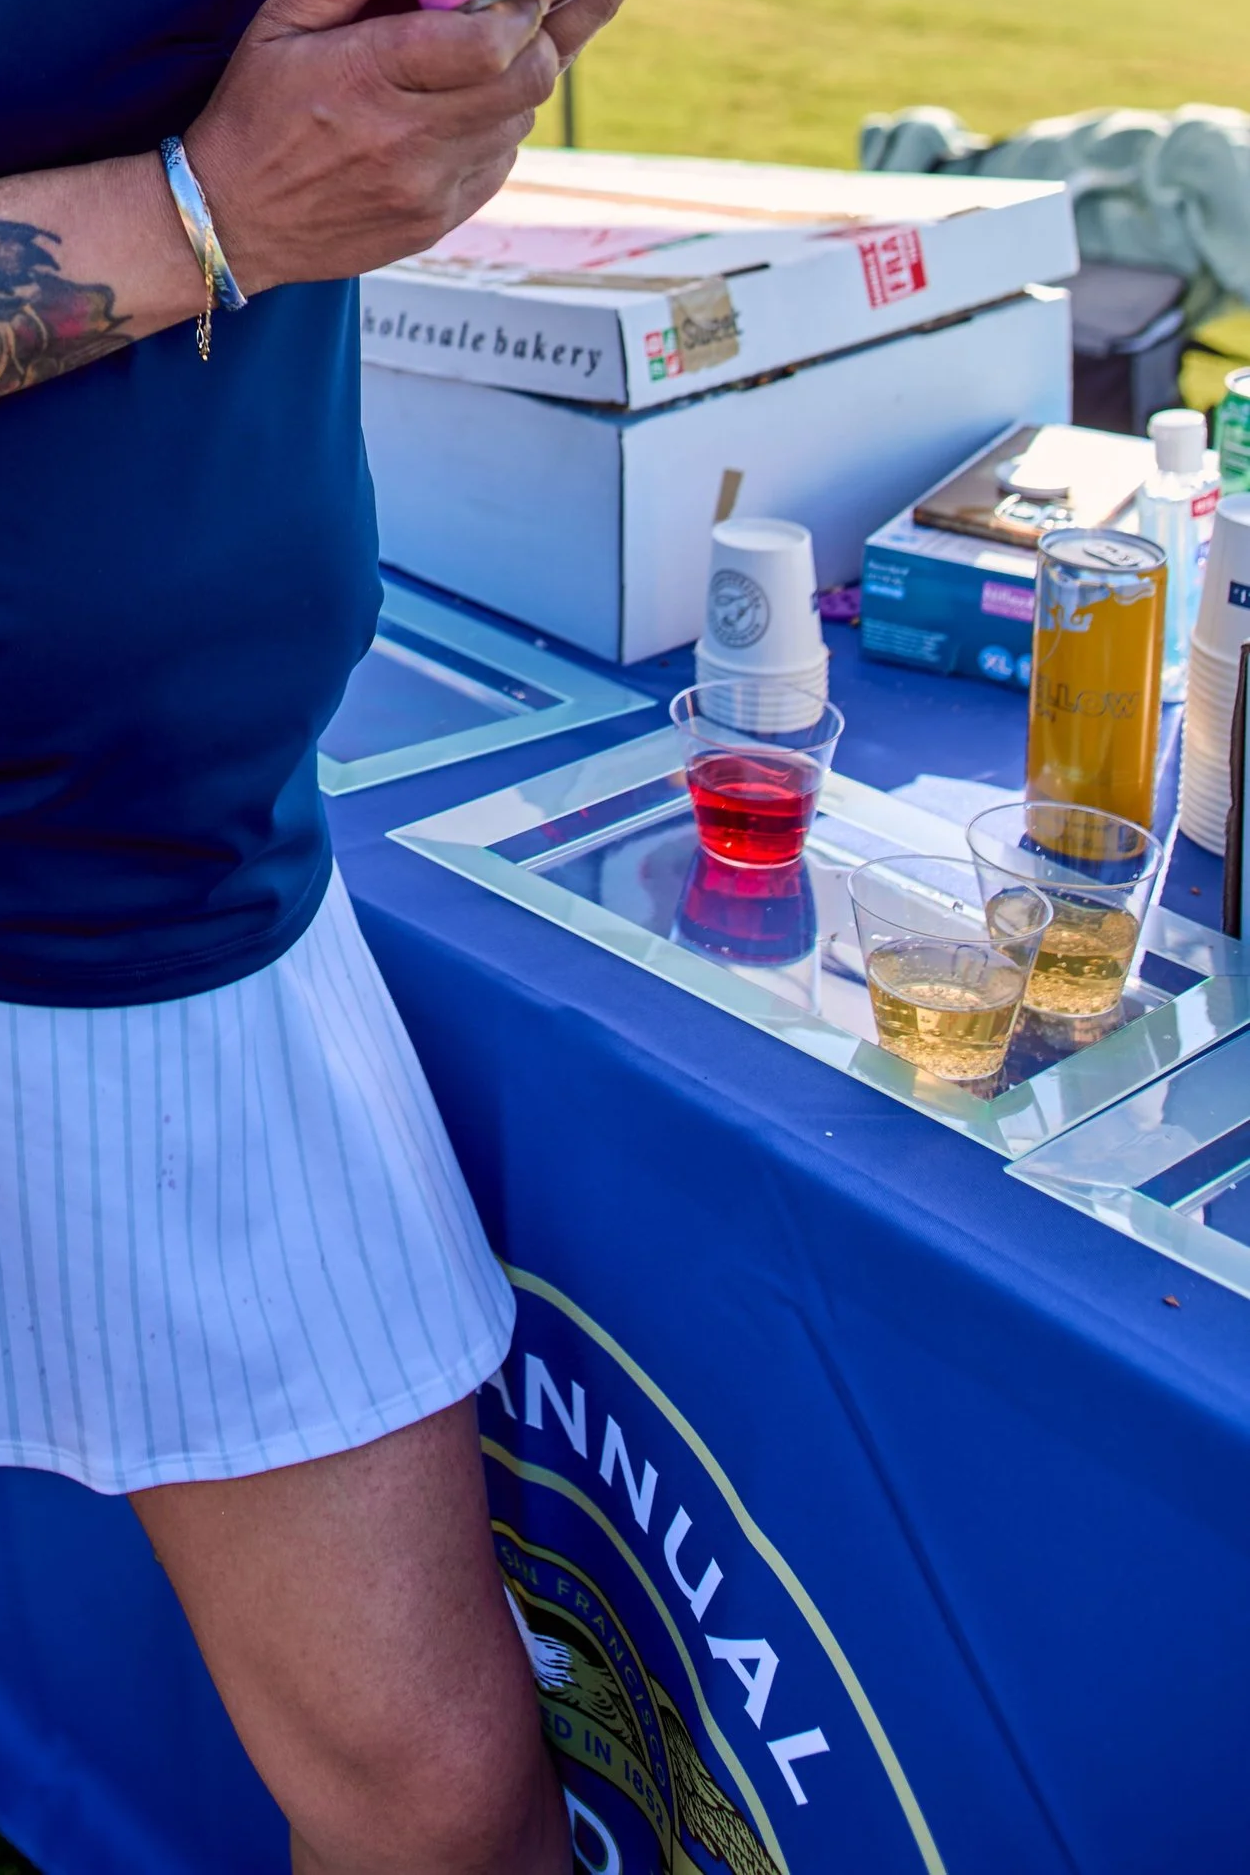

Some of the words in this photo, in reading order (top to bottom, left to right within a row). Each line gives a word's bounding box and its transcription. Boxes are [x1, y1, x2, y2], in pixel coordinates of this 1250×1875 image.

[363, 306, 486, 352] holesale
[493, 326, 603, 376] bakery
[983, 652, 1012, 676] XL
[556, 1576, 666, 1788] FRANCISCO
[584, 1728, 613, 1767] IN
